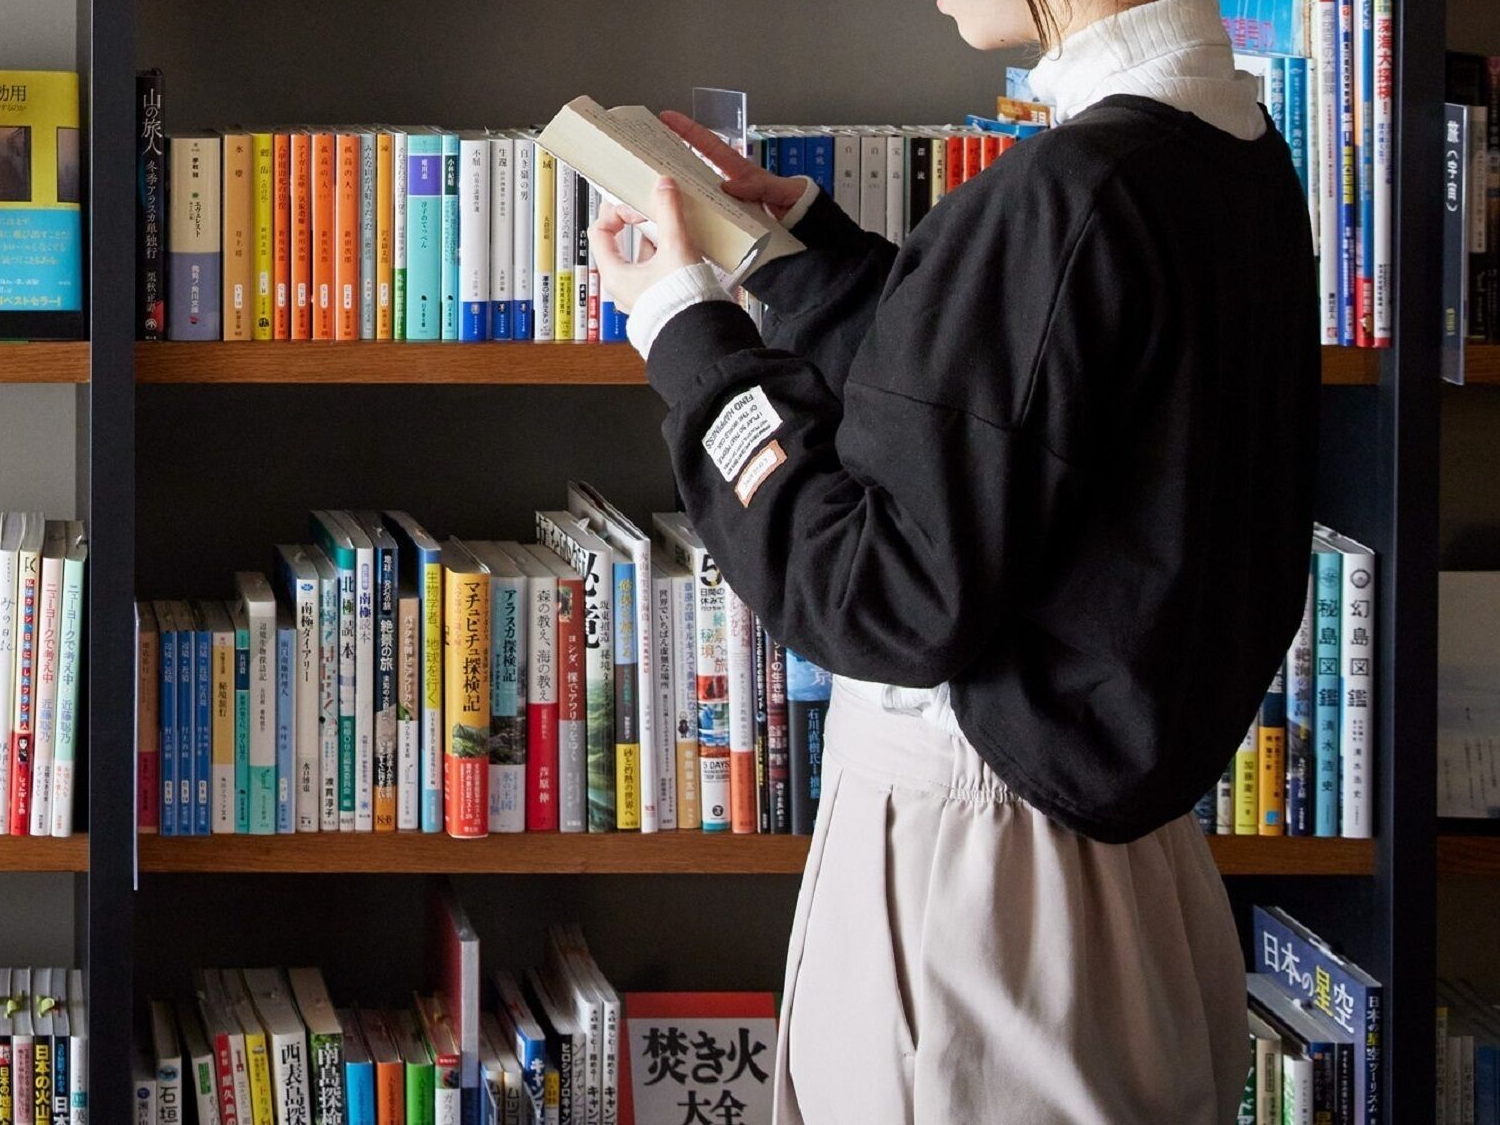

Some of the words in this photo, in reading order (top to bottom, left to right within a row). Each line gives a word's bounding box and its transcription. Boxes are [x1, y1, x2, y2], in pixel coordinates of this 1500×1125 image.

[141, 87, 164, 157] 山の旅人
[462, 581, 481, 713] マチュピチュ探検記
[536, 588, 550, 702] 森の教え、海の教え
[1262, 930, 1355, 1035] 日本の星空
[642, 1026, 770, 1087] 焚き火
